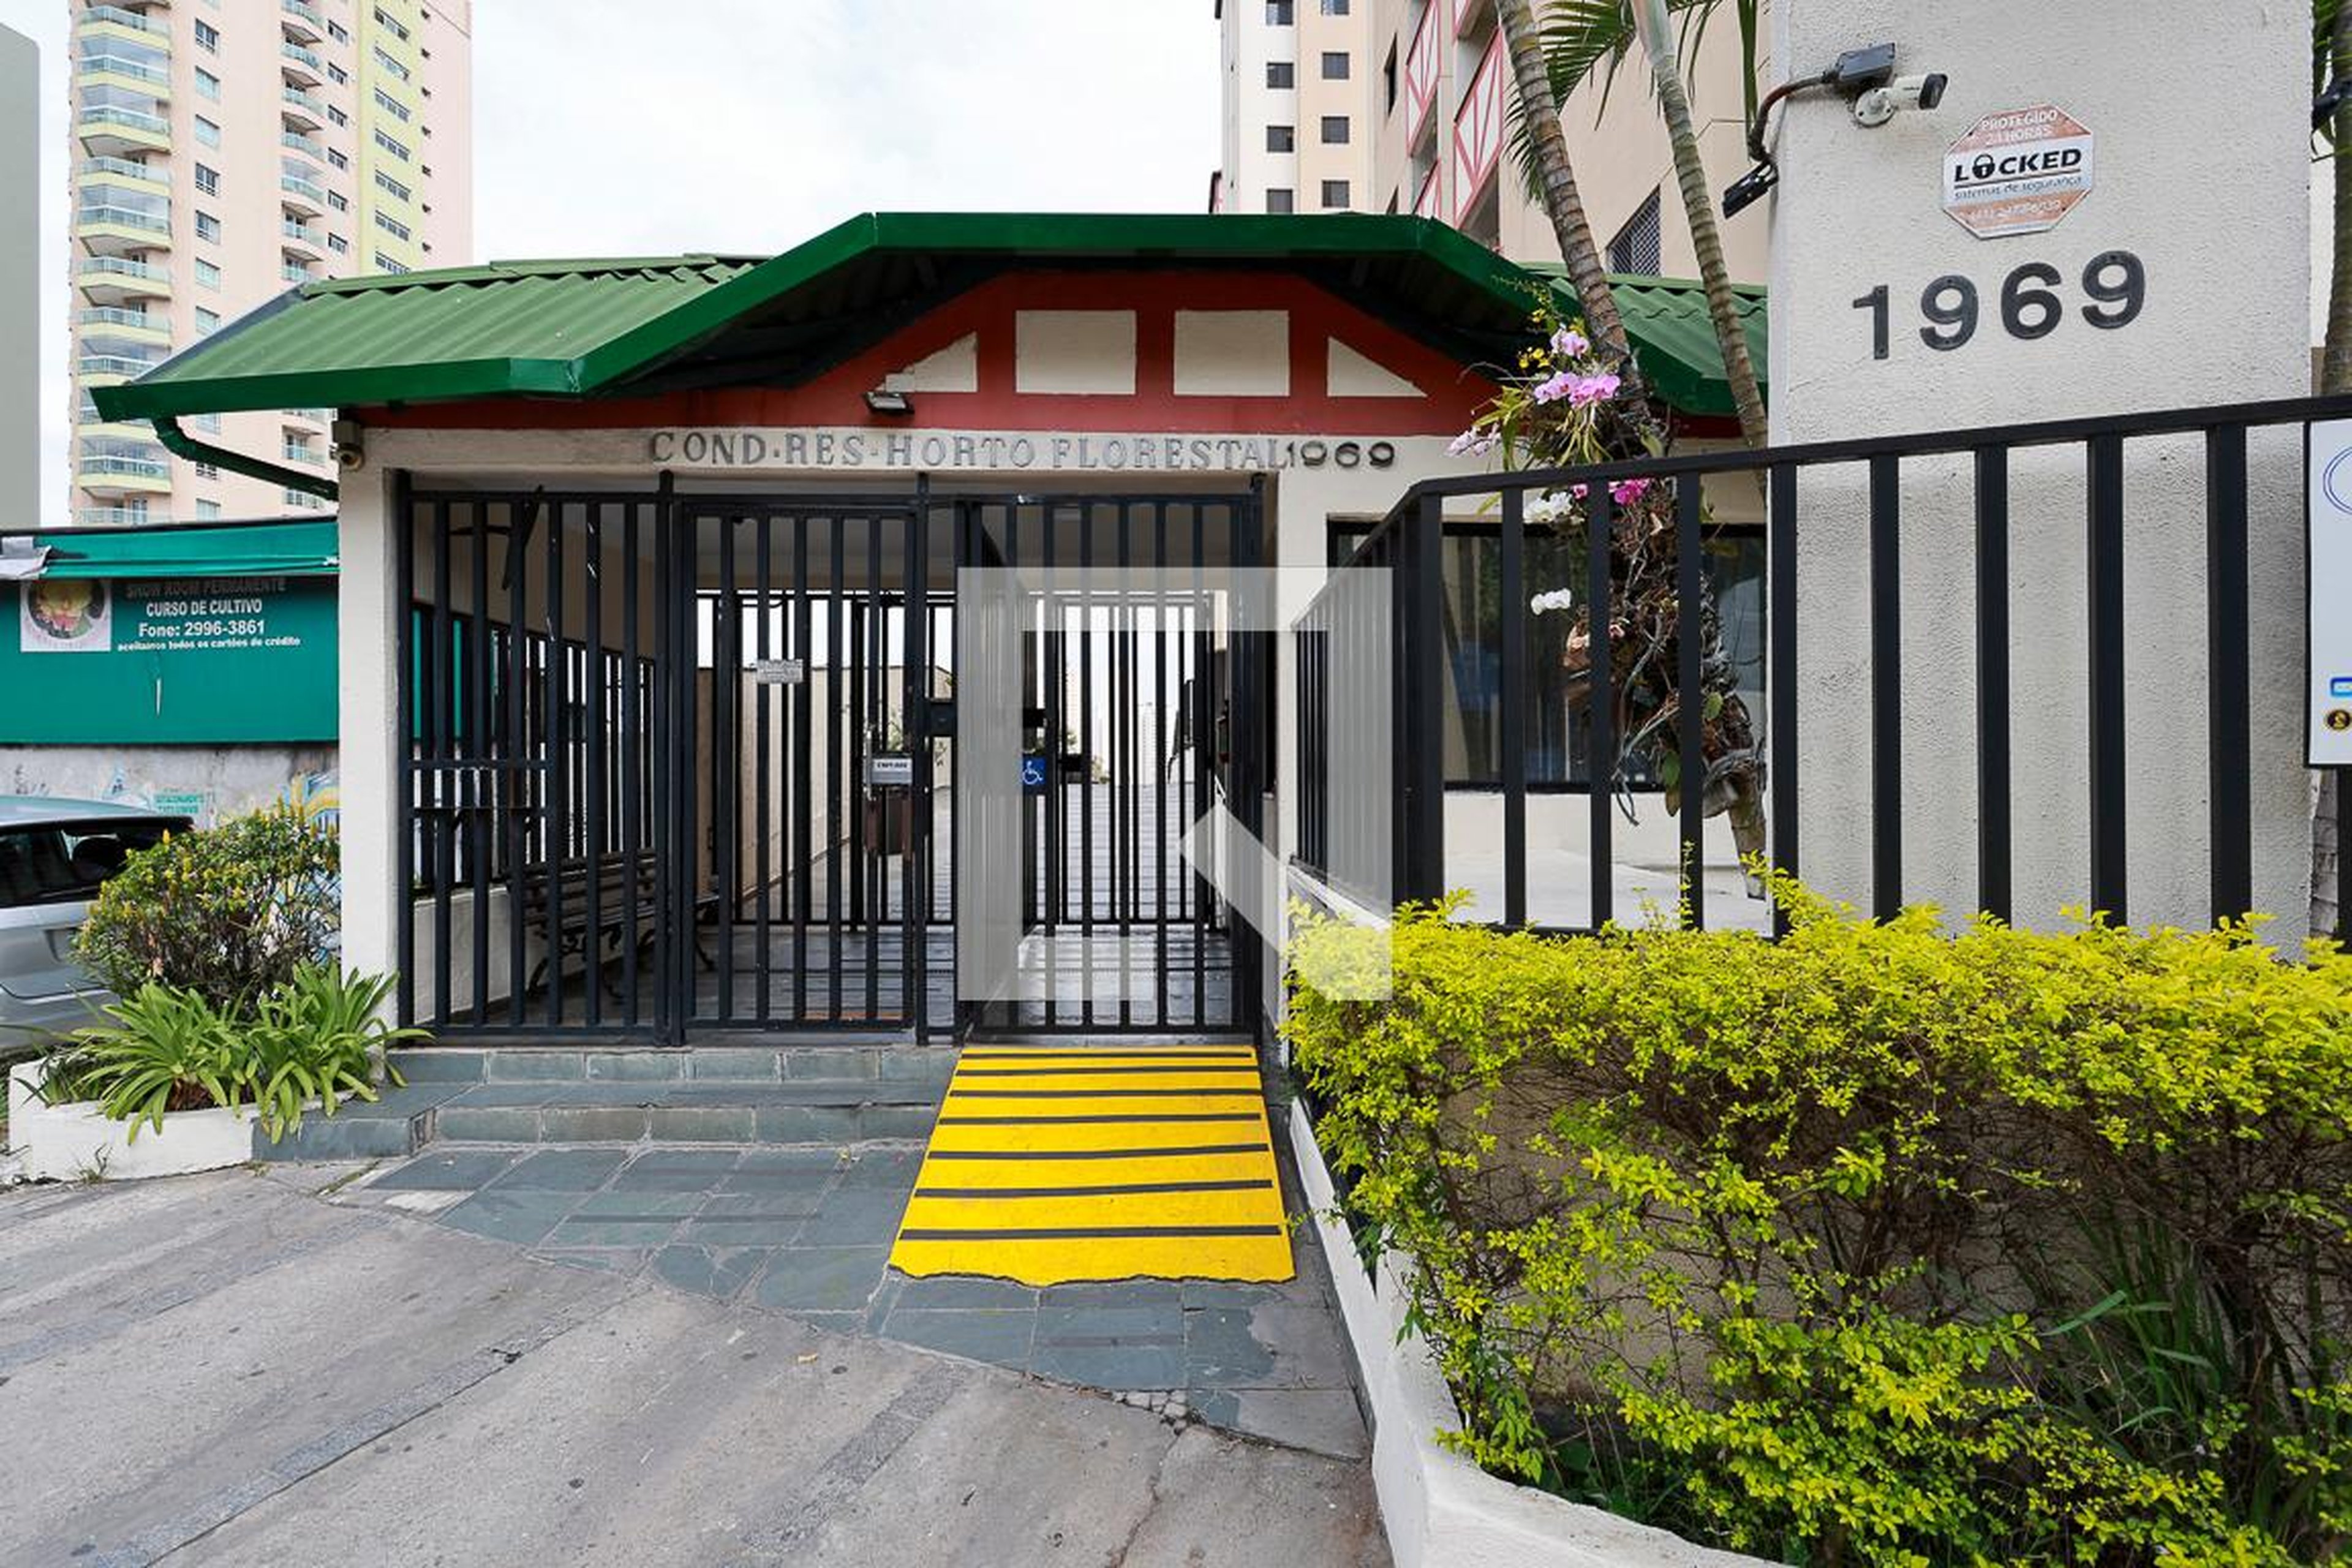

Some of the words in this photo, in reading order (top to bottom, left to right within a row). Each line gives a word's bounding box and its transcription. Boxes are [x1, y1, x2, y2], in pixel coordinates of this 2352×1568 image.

[1981, 109, 2057, 130] PROTEGIDO
[1954, 149, 2082, 183] LOCKED
[1853, 250, 2146, 360] 1969
[886, 433, 1036, 468] HORTO
[1051, 437, 1287, 470] FLORESTAL
[146, 601, 187, 617] CURSO
[190, 600, 207, 616] DE
[209, 598, 263, 614] CULTIVO
[138, 622, 181, 637] Fone:
[184, 620, 265, 636] 2996-3861
